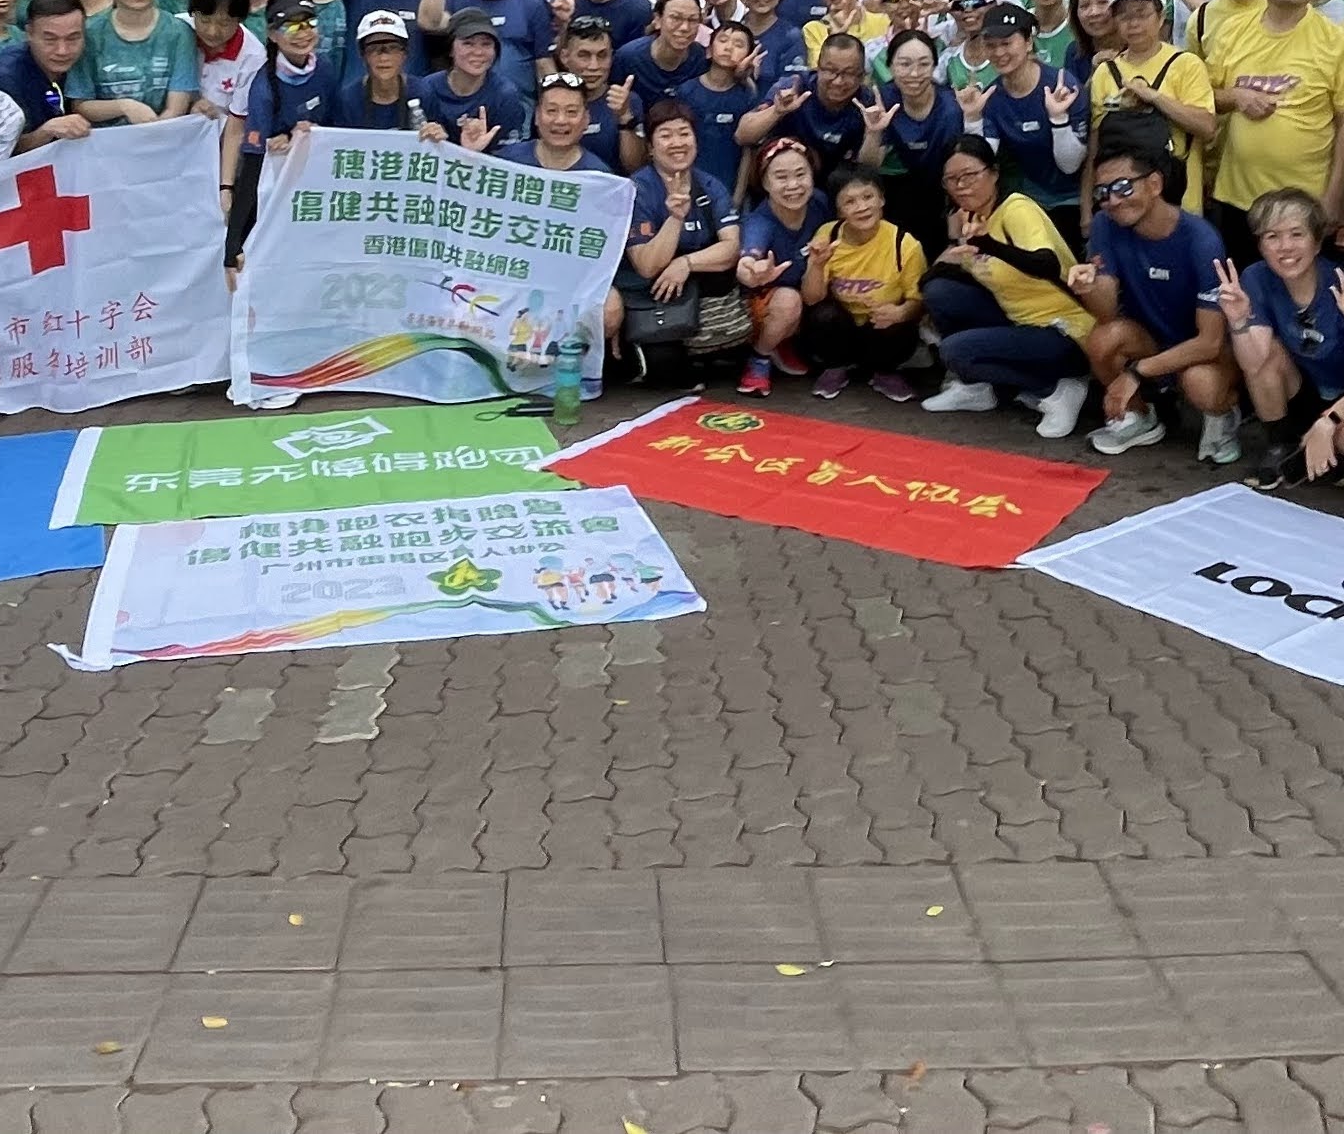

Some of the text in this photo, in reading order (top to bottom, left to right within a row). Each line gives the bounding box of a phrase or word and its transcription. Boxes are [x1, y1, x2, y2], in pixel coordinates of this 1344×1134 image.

[331, 148, 582, 213] 穗港跑衣捐贈暨
[290, 189, 609, 259] 傷健共融跑步交流會
[320, 272, 409, 310] 2023
[280, 574, 407, 605] 2023
